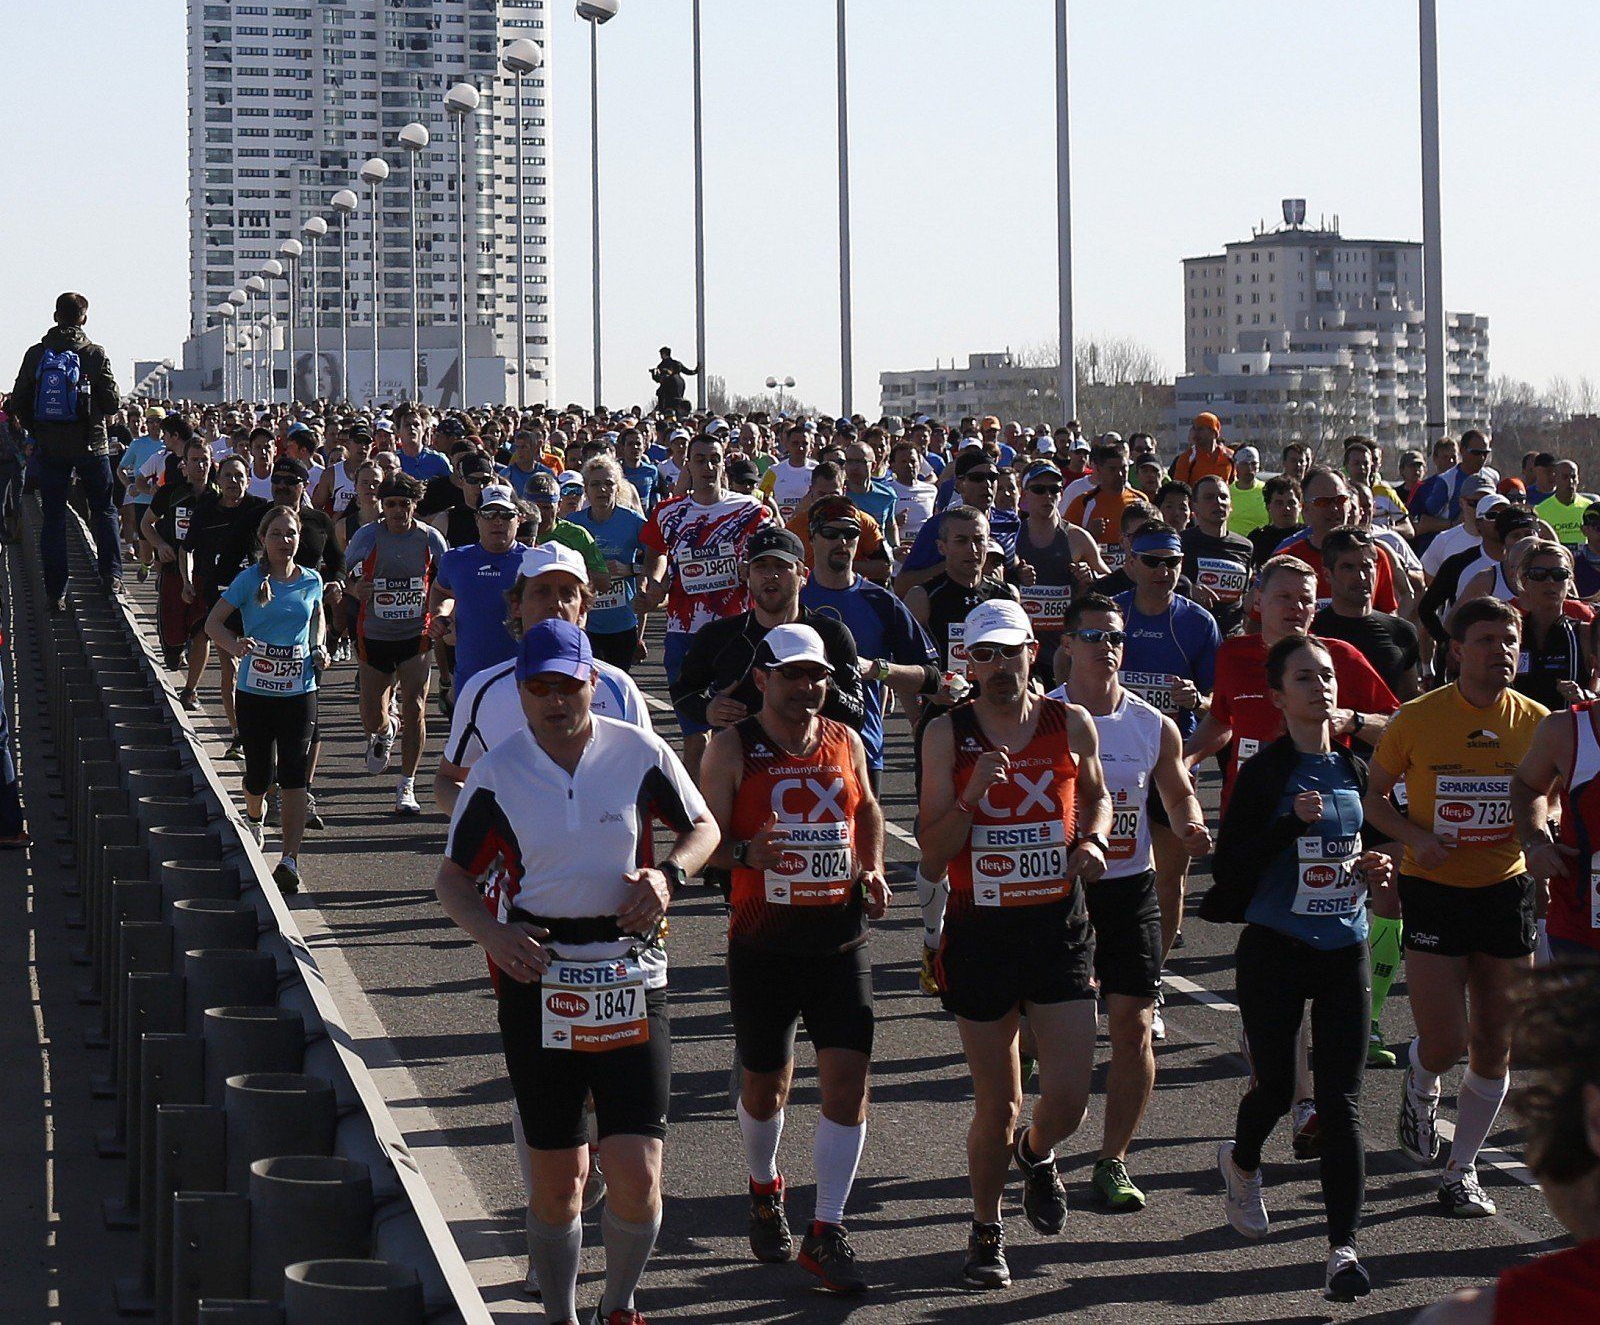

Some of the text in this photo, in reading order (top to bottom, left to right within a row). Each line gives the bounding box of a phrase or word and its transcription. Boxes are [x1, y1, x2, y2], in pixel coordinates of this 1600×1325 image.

[693, 546, 716, 557] OMV
[704, 557, 737, 577] 19610
[388, 580, 409, 588] OMV
[685, 579, 729, 592] SPARKASSE
[1220, 575, 1243, 591] 6460
[1021, 587, 1063, 597] SPARKASSE
[382, 609, 408, 619] ERSTE
[1142, 630, 1164, 639] asics
[268, 647, 291, 656] OMV
[256, 678, 285, 692] ERSTE
[1123, 672, 1163, 686] ERSTE
[1466, 740, 1501, 749] skinfit
[1438, 780, 1509, 793] SPARKASSE
[770, 777, 846, 823] CX
[1441, 805, 1473, 819] Hervis
[986, 827, 1038, 846] ERSTE
[776, 851, 847, 878] ervis 8024
[979, 848, 1062, 879] Hervis 8019
[1306, 870, 1334, 884] Hervis
[1305, 896, 1350, 913] ERSTE
[559, 965, 615, 985] ERSTE
[551, 987, 637, 1021] Hervis 1847
